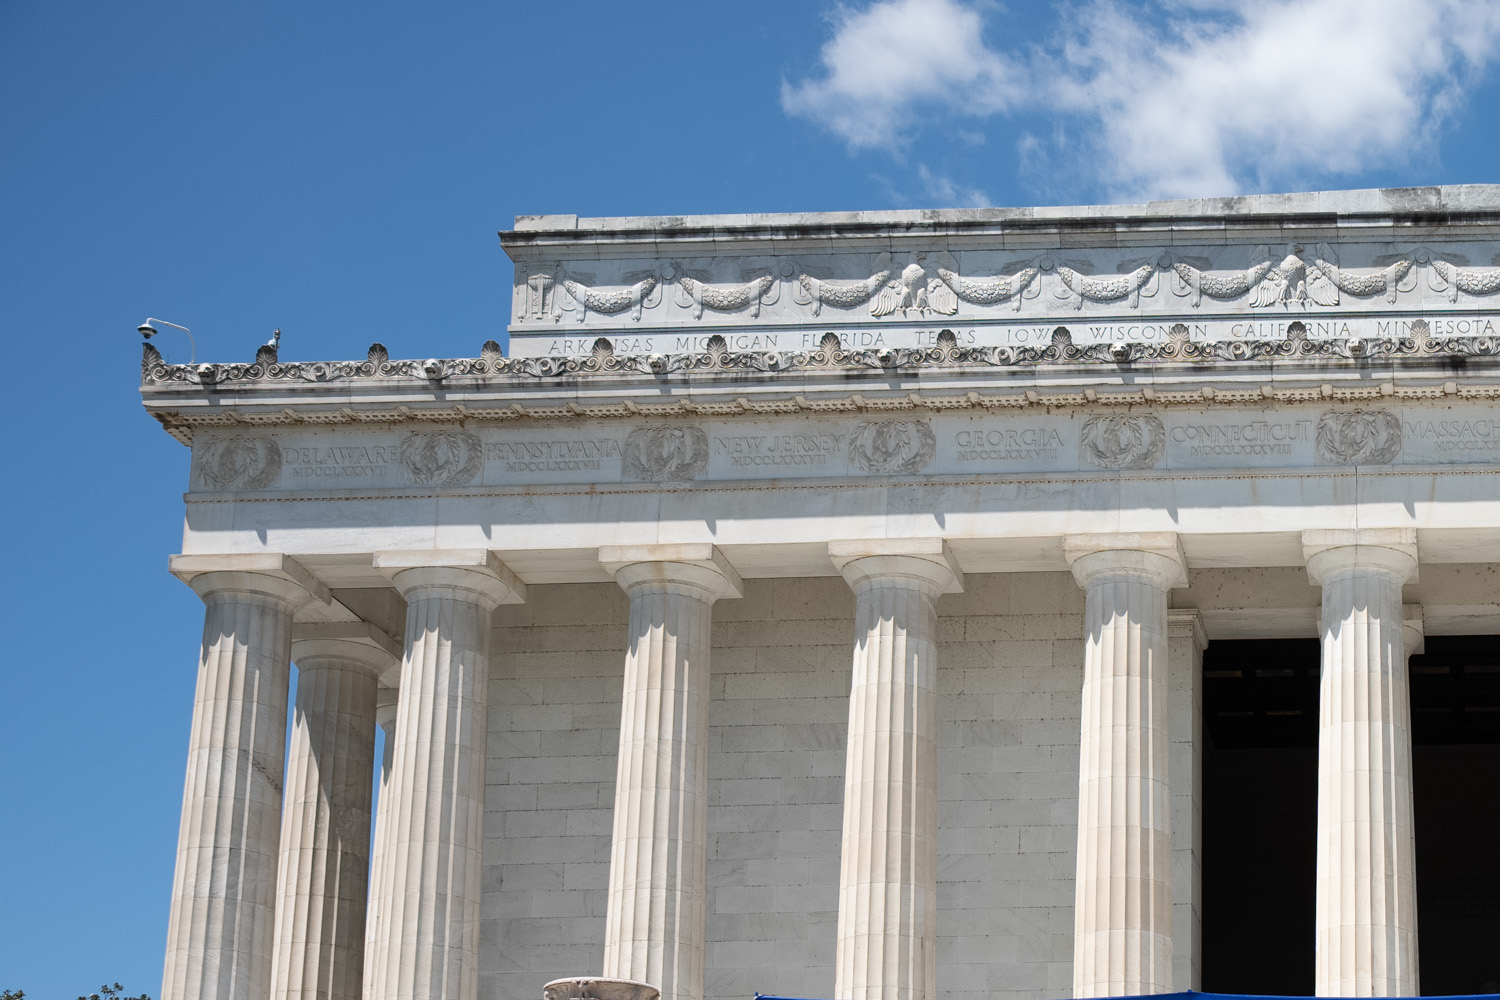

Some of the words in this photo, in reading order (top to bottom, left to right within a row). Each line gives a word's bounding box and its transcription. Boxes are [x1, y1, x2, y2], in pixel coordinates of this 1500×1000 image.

[1089, 325, 1208, 340] WISCONN
[1231, 322, 1352, 338] CALIFRNIA
[1377, 319, 1497, 337] MINESOTA
[548, 337, 654, 354] ARKNSAS
[676, 334, 778, 351] MICIGAN
[802, 332, 886, 348] FLRIDA
[915, 330, 976, 345] TEAS
[955, 428, 1064, 448] GEORGIA
[1170, 420, 1313, 443] CONNECTICUT
[486, 439, 623, 460] PENNSYLVANIA
[715, 436, 767, 455] NEW
[768, 434, 846, 453] JERSEY
[283, 446, 398, 465] DELAWARE
